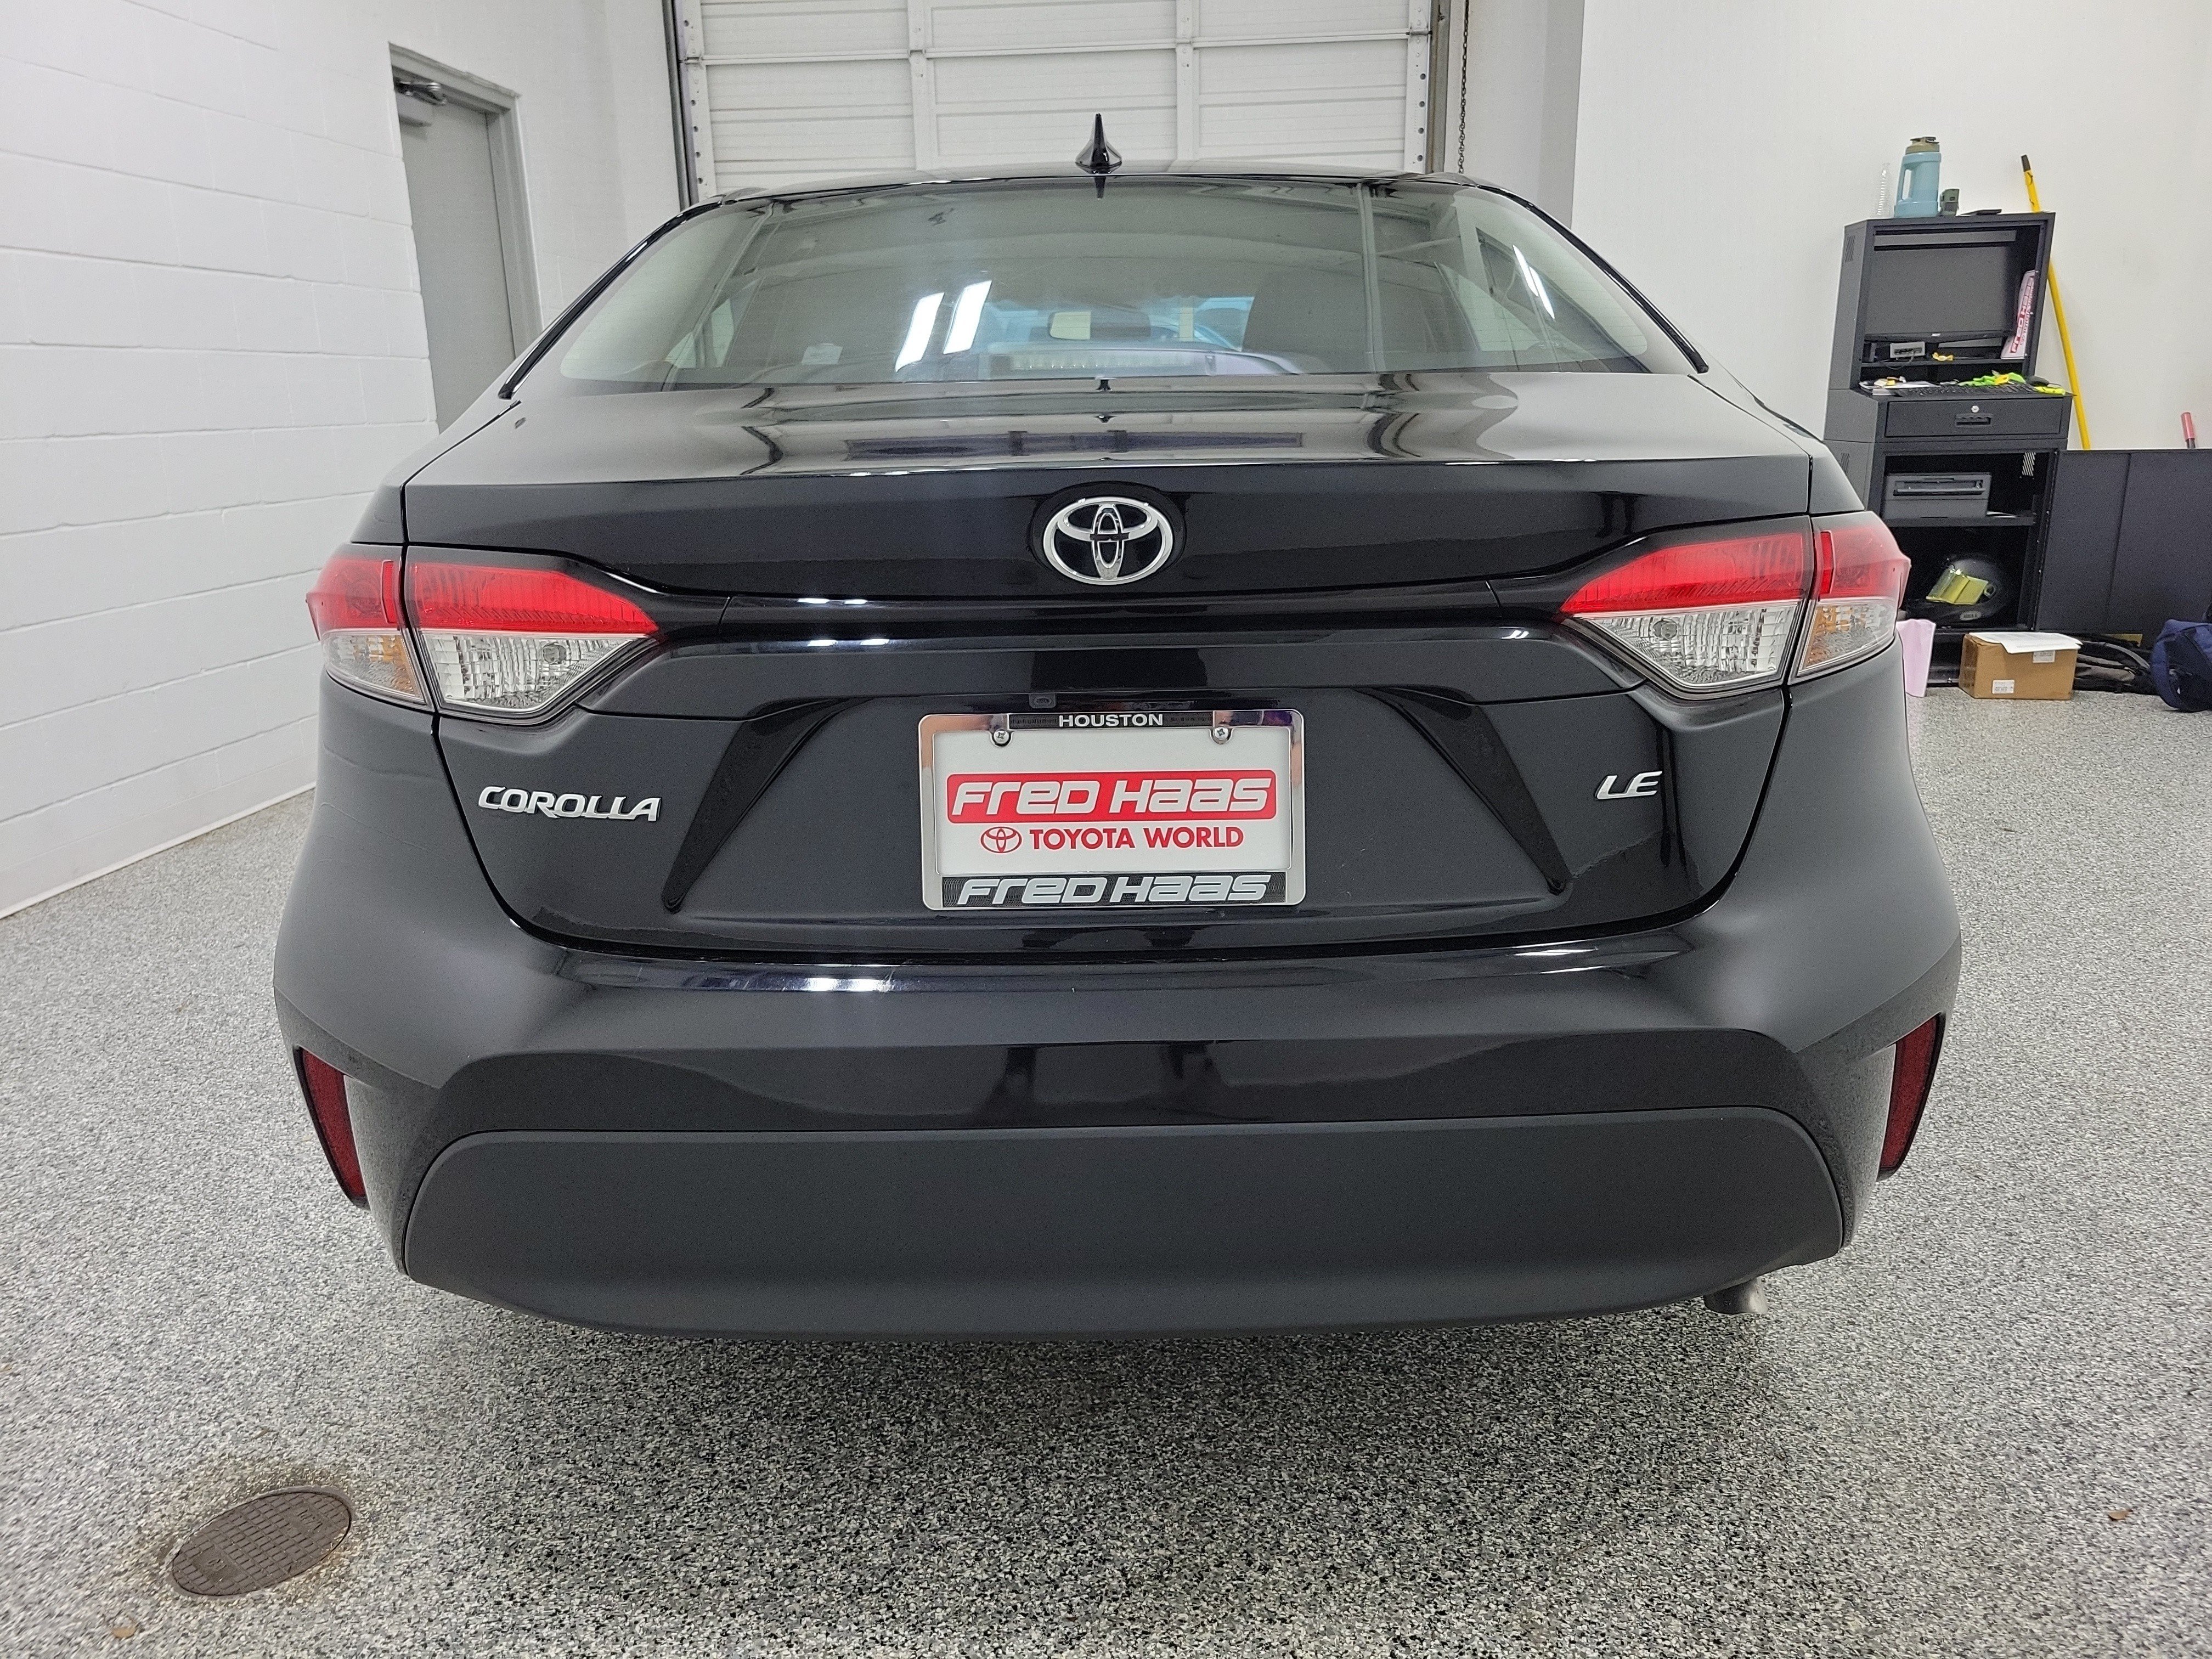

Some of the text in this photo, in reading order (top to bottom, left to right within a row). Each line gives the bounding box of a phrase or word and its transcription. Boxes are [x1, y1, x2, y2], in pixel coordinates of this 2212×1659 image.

[1059, 714, 1163, 727] HOUSTON
[1596, 770, 1663, 799] LE
[478, 786, 662, 821] COROLLA
[1029, 826, 1244, 850] TOYOTA WORLD
